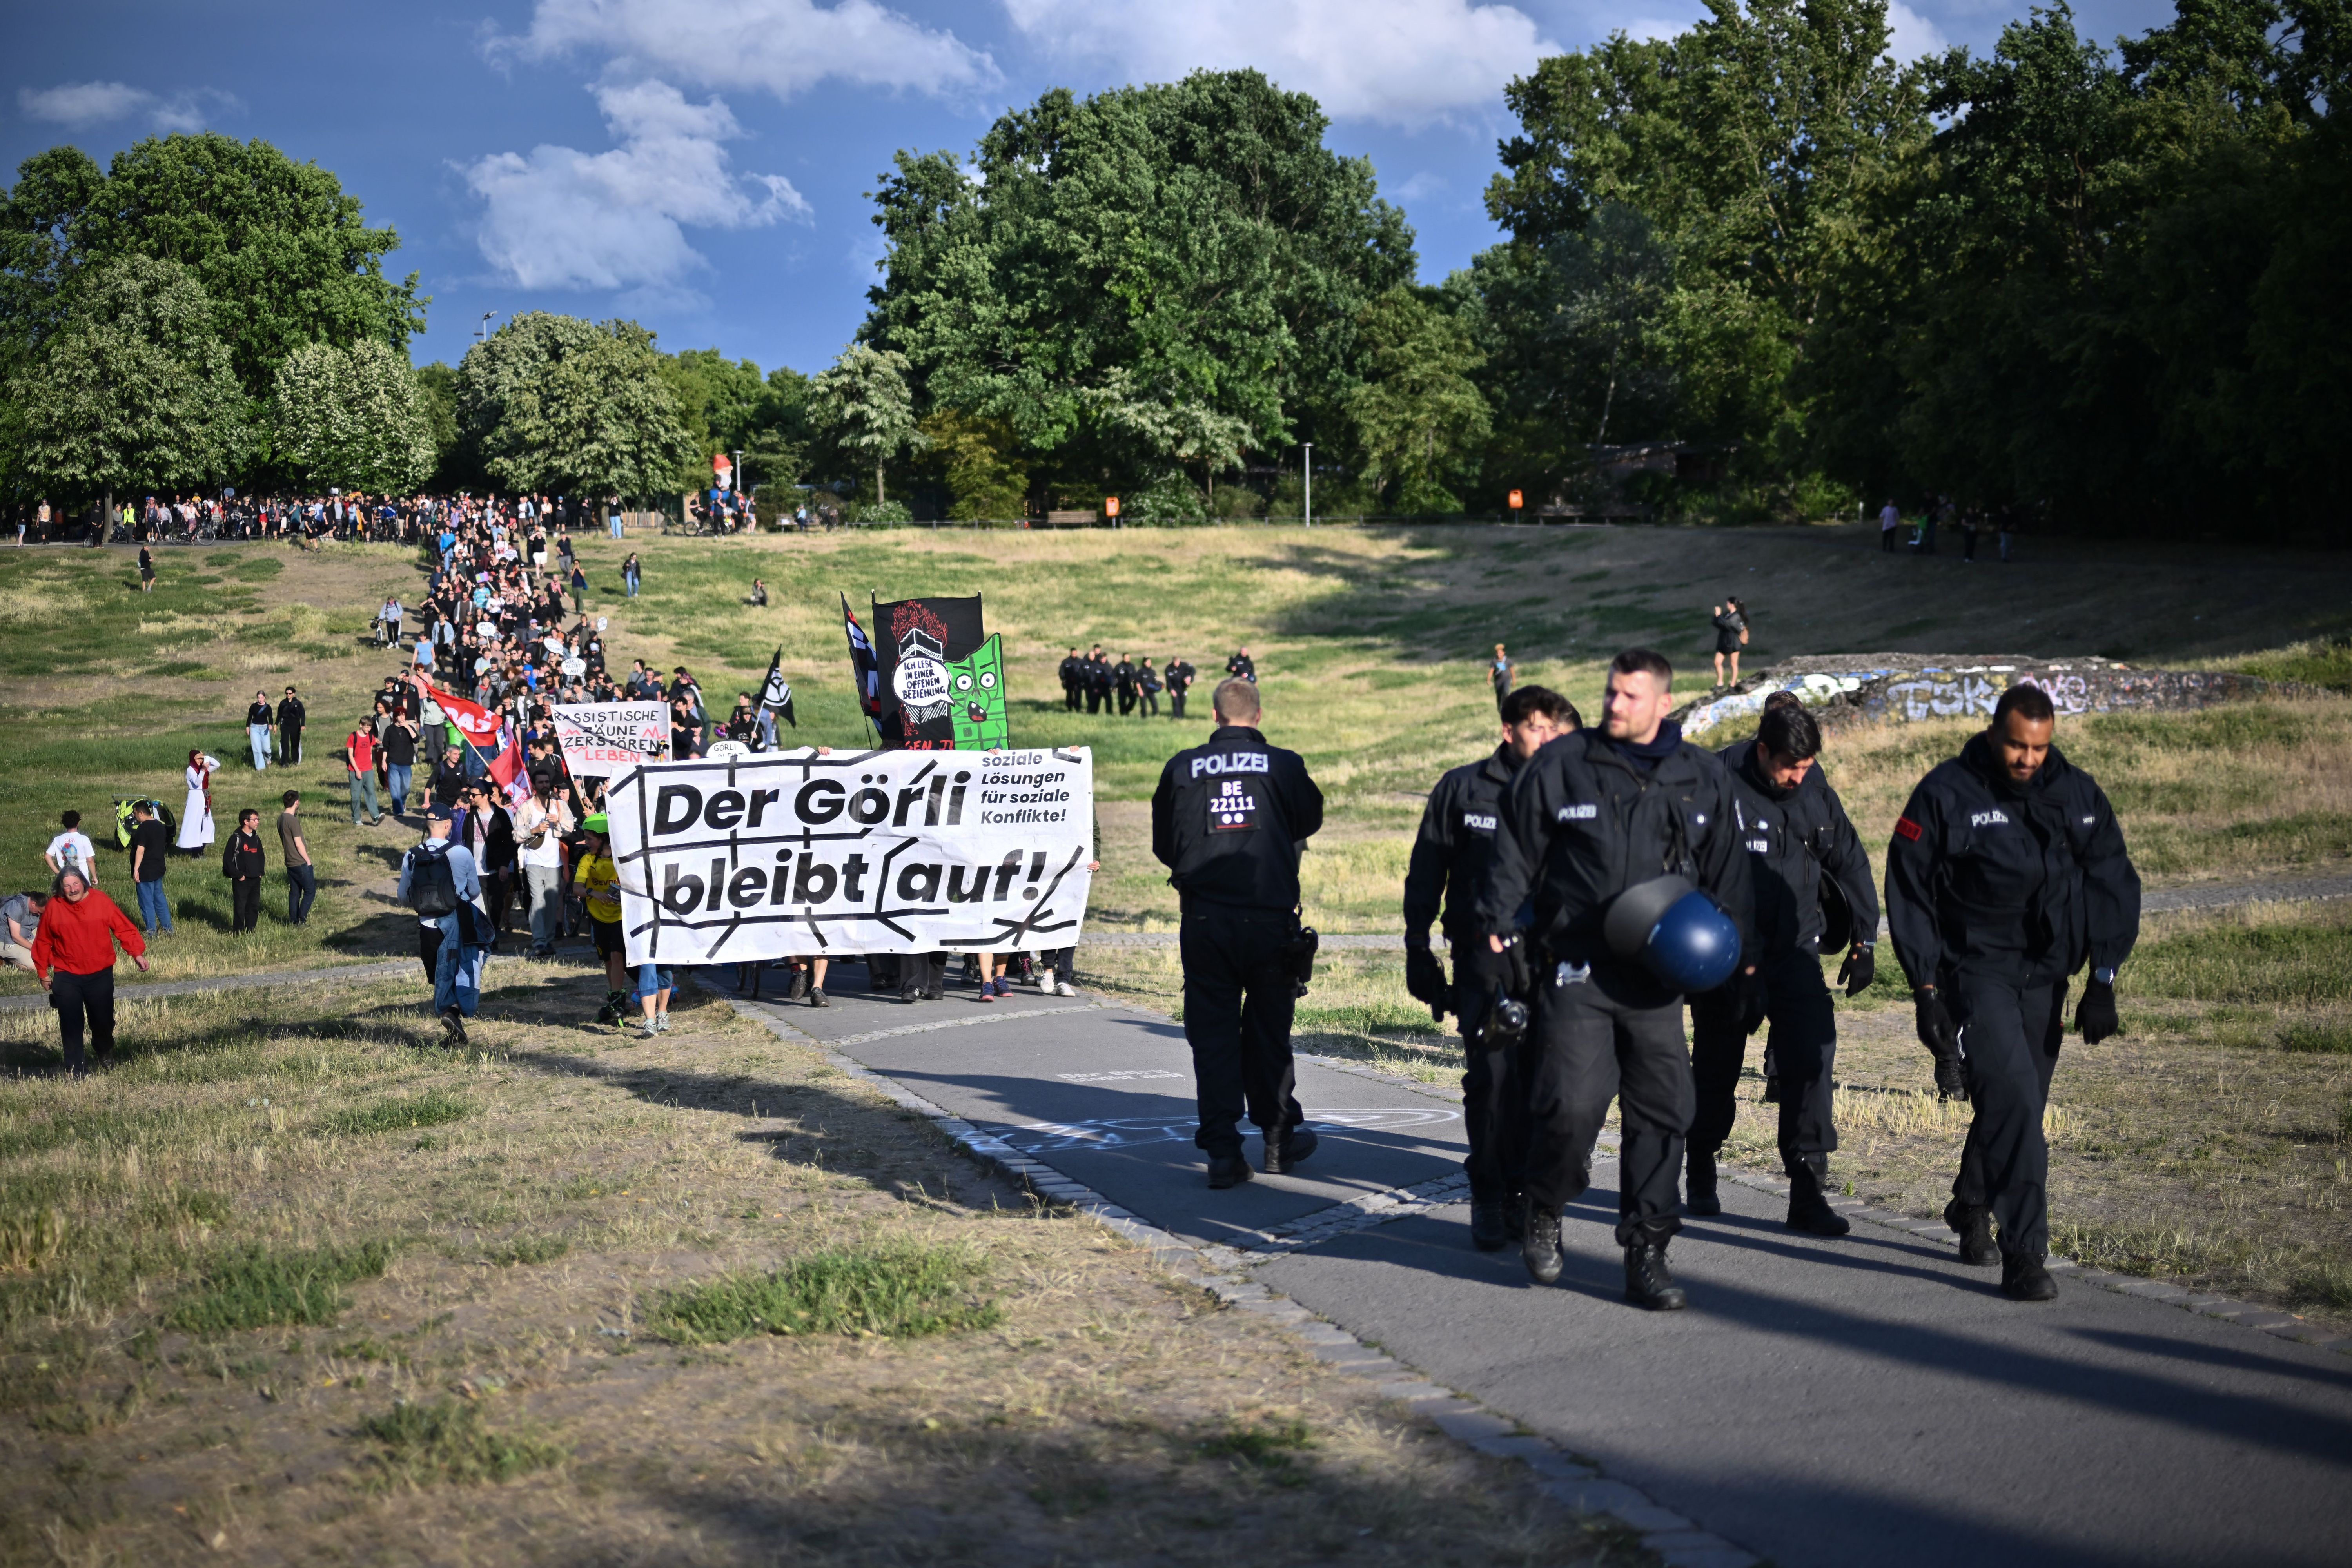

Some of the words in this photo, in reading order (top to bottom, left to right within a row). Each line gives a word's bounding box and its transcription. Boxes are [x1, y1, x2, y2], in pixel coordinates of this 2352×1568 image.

[904, 661, 916, 670] ICH
[918, 660, 933, 669] LEBE
[905, 671, 913, 680] IN
[914, 669, 935, 679] EINER
[907, 677, 940, 689] OFFENEN
[902, 686, 946, 700] BEZIEHUNG
[554, 710, 659, 723] RASSISTISCHE
[583, 724, 637, 736] ZÄUNE
[564, 737, 660, 751] ZERSTÖREN
[714, 743, 736, 751] GÖRLI
[585, 750, 640, 763] LEBEN
[982, 751, 1042, 767] soziale
[1192, 752, 1268, 778] POLIZEI
[981, 772, 1065, 788] Lösungen
[1222, 780, 1242, 796] BE
[653, 784, 779, 836] Der
[795, 771, 971, 827] Görli
[981, 790, 1007, 804] für
[1010, 789, 1069, 803] soziale
[1210, 796, 1255, 813] 22111
[981, 809, 1066, 824] Konflikte!
[1558, 804, 1597, 822] POLIZEI
[1465, 813, 1497, 829] POLIZE
[664, 849, 869, 916] bleibt
[897, 849, 1047, 903] auf!
